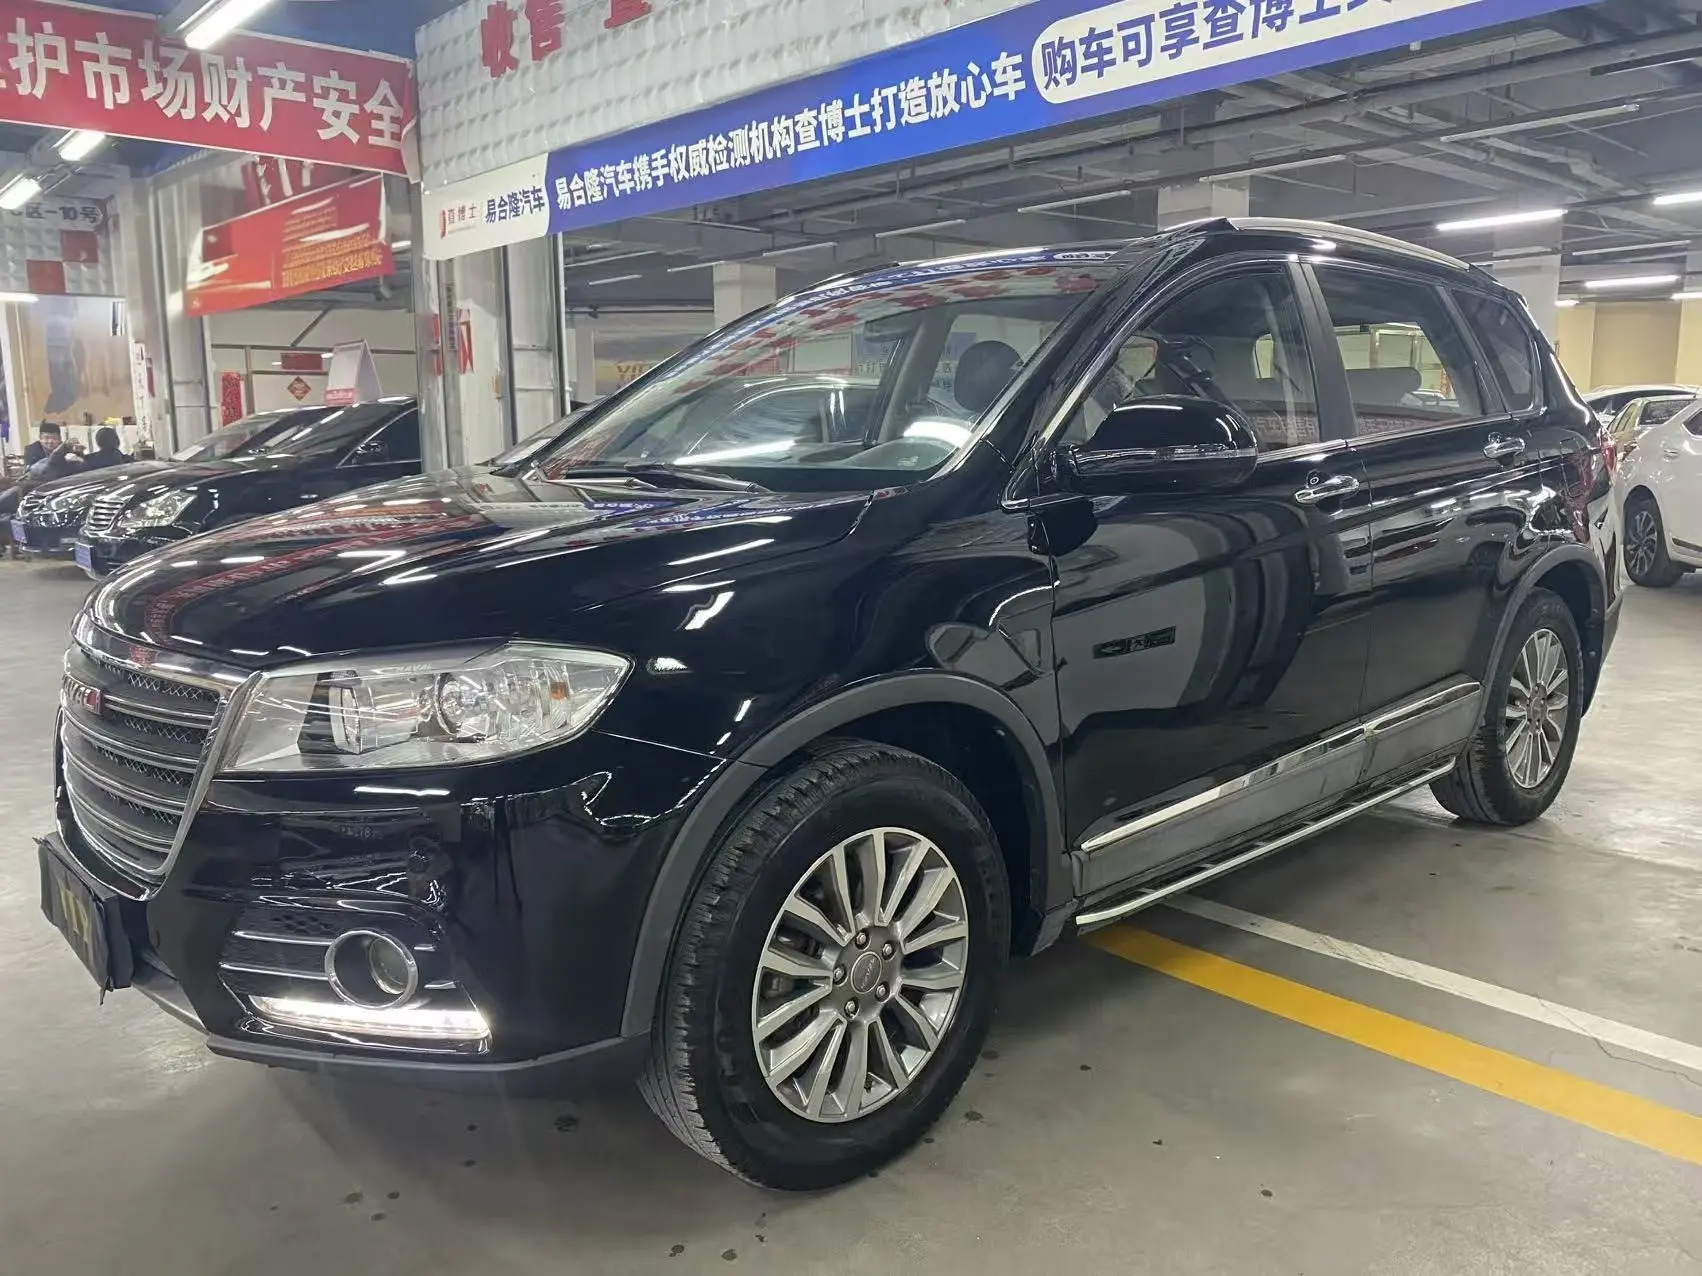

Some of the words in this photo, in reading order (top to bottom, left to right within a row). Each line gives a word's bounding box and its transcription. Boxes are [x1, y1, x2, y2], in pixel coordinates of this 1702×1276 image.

[0, 17, 404, 149] 护市场财产安全
[555, 51, 1026, 210] 易合隆汽车携手权威检测机构查博士打造放心车
[485, 186, 546, 224] 易合隆汽车
